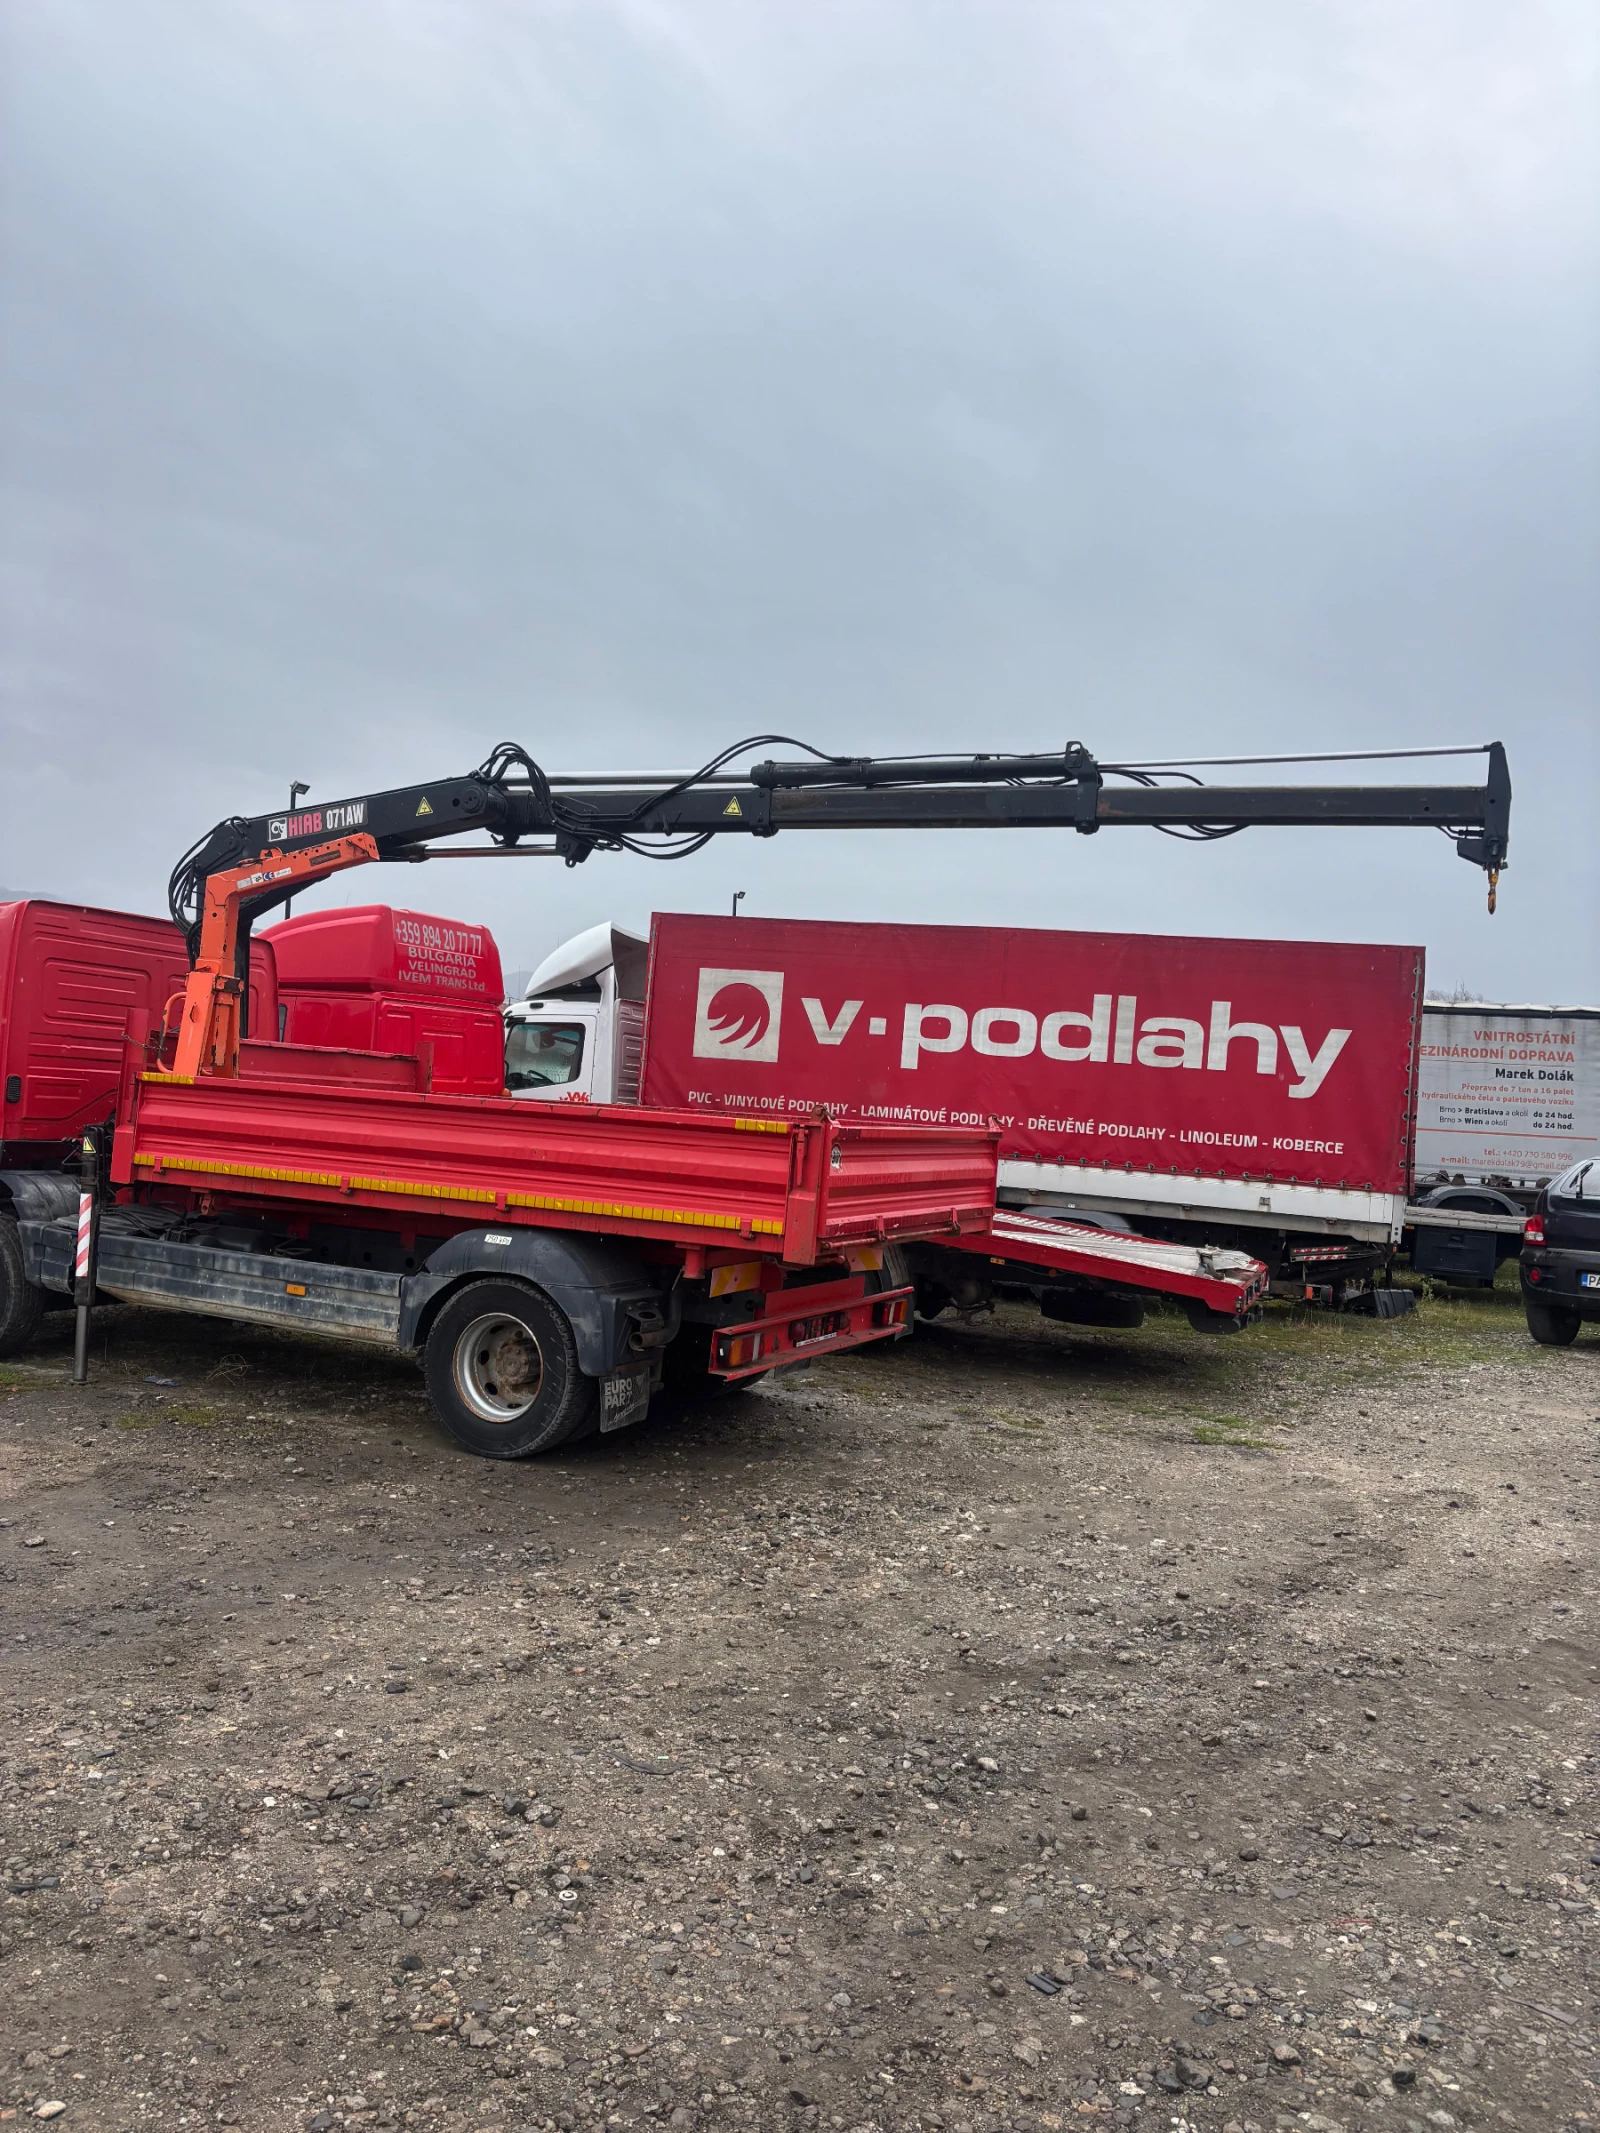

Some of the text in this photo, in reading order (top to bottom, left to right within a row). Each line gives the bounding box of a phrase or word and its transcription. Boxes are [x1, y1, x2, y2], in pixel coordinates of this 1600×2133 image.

[288, 803, 365, 837] HIAB 071AW
[395, 920, 482, 955] +359 894 20 77 77
[408, 946, 476, 968] BULGARIA
[408, 960, 476, 979] VELINGRAD
[398, 970, 485, 991] IVEM TRANS Ltd
[1473, 1030, 1576, 1045] VNITROSTÁTNÍ
[1420, 1044, 1575, 1063] EZINÁRODNÍ DOPRAVA
[1495, 1068, 1574, 1081] Marek Dolák
[1518, 1086, 1531, 1094] tun
[1553, 1088, 1574, 1096] palet
[1439, 1105, 1456, 1113] Brno
[1464, 1107, 1504, 1116] Bratislava
[1533, 1110, 1543, 1118] do
[1545, 1111, 1556, 1119] 24
[1557, 1112, 1575, 1120] hod.
[688, 1091, 713, 1104] PVC
[724, 1094, 786, 1110] VINYLOVÉ
[788, 1099, 849, 1115] PODAHY
[860, 1104, 947, 1123] LAMINÁTOVÉ
[950, 1111, 1015, 1128] PODLHY
[1027, 1115, 1095, 1135] DŘEVĚNÉ
[1098, 1123, 1166, 1141] PODLAHY
[1179, 1130, 1258, 1148] LINOLEUM
[1272, 1137, 1344, 1155] KOBERCE
[1439, 1116, 1456, 1124] Brno
[1464, 1117, 1484, 1125] Wien
[1533, 1121, 1543, 1129] do
[1557, 1122, 1574, 1130] hod.
[1440, 1156, 1470, 1165] e-mail:
[1503, 1150, 1522, 1158] +420
[1557, 1153, 1574, 1161] 996
[604, 1377, 633, 1396] EURO
[604, 1390, 633, 1410] PART
